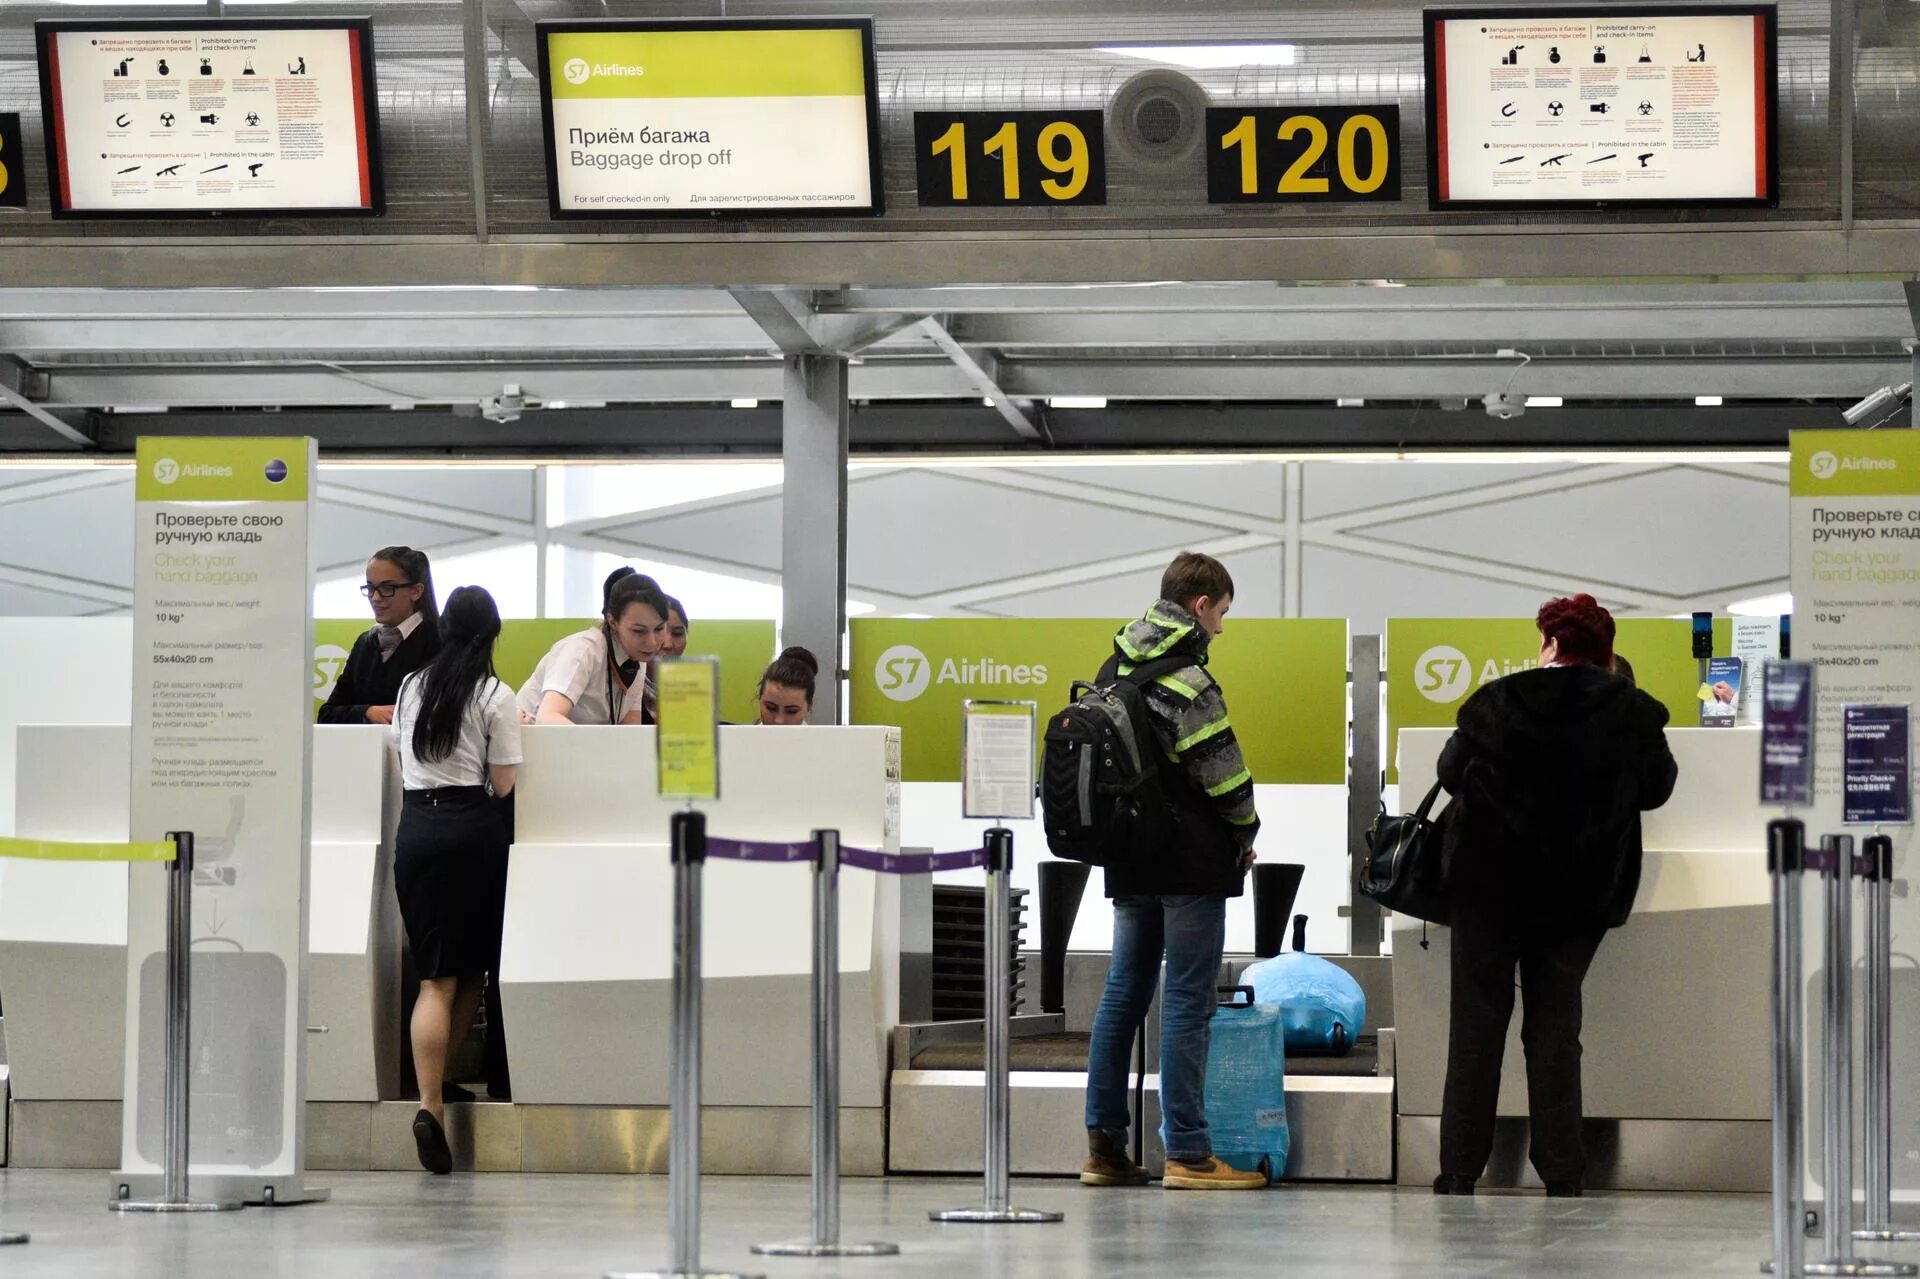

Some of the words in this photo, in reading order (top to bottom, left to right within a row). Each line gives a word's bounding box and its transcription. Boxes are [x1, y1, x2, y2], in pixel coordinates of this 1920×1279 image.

[593, 63, 644, 77] Airlines
[569, 127, 635, 148] Приём
[640, 125, 710, 145] багажа
[210, 151, 241, 159] Prohibited
[571, 151, 654, 171] Baggage
[659, 150, 702, 169] drop
[707, 149, 732, 166] off
[931, 120, 1090, 200] 119
[1221, 114, 1390, 195] 120
[574, 196, 588, 204] For
[590, 195, 605, 204] self
[606, 195, 651, 204] checked-in
[652, 195, 670, 206] only
[690, 195, 706, 204] Для
[708, 194, 800, 204] зарегистрированных
[801, 193, 856, 203] пассажиров
[182, 464, 233, 477] Airlines
[1840, 456, 1897, 471] Airlines
[155, 512, 238, 531] Проверьте
[242, 515, 284, 527] свою
[1812, 508, 1903, 525] Проверьте
[155, 530, 213, 545] ручную
[217, 530, 263, 544] кладь
[1812, 527, 1876, 542] ручную
[154, 552, 201, 567] Check
[205, 555, 237, 571] your
[1812, 551, 1863, 565] Check
[1866, 553, 1902, 568] your
[154, 569, 190, 582] hand
[194, 568, 258, 585] baggage
[1811, 567, 1851, 581] hand
[156, 613, 167, 622] 10
[1814, 613, 1826, 622] 10
[153, 655, 197, 664] 55x40x20
[199, 656, 214, 664] cm
[1862, 658, 1879, 666] cm
[936, 657, 1048, 685] Airlines
[1847, 775, 1869, 784] Priority
